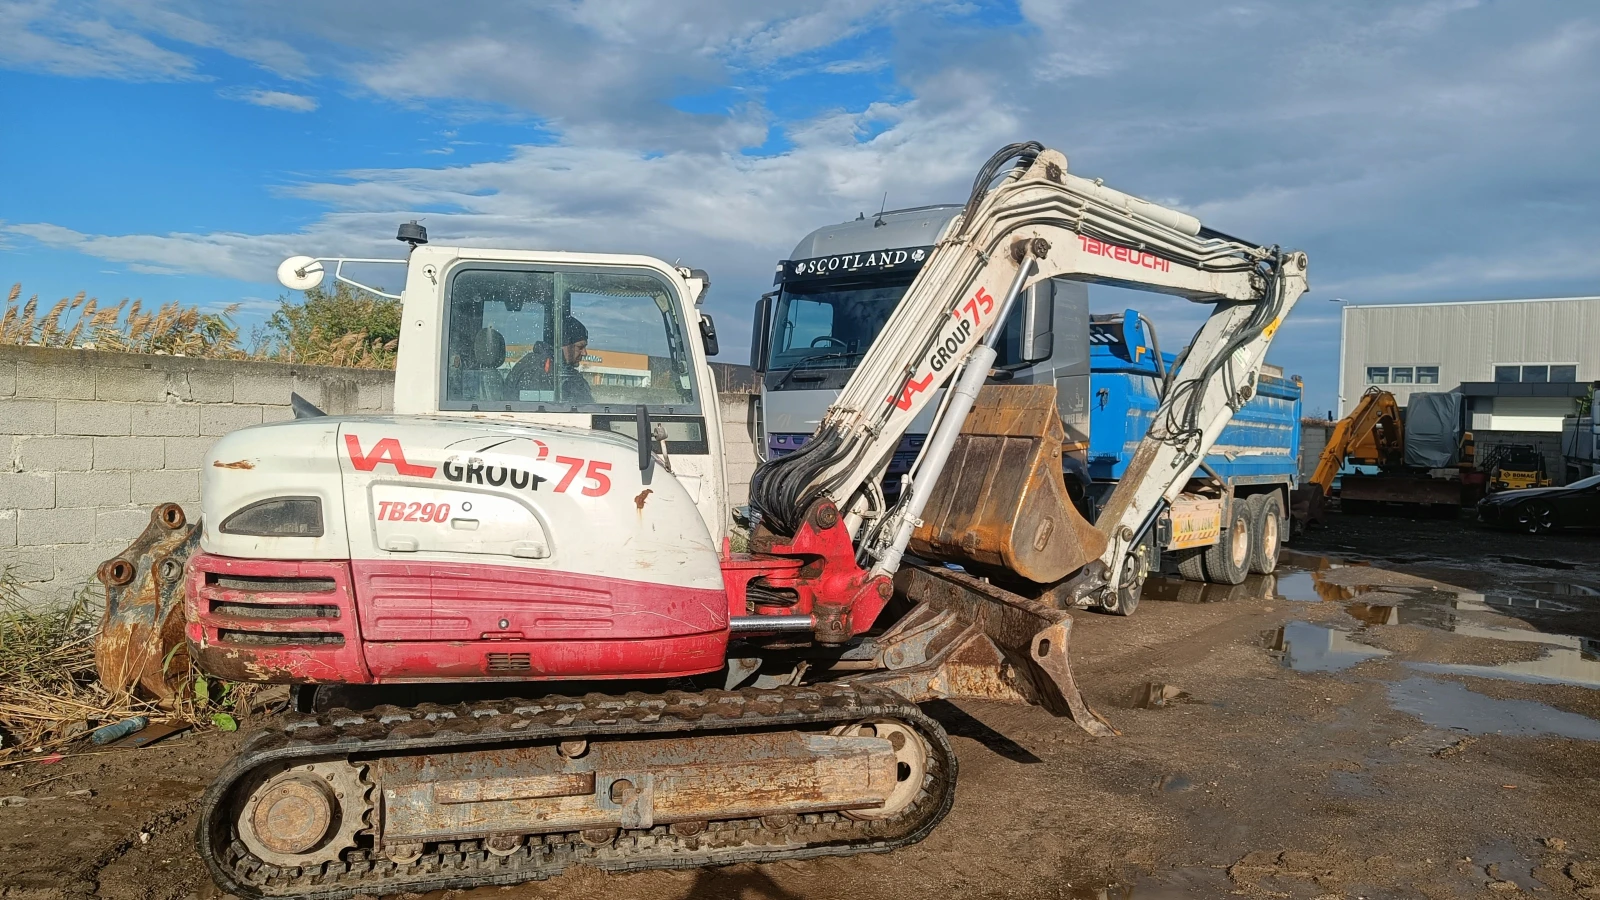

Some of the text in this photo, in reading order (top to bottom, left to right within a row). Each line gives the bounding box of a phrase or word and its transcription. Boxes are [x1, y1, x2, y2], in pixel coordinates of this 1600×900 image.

[807, 250, 908, 274] SCOTLAND
[930, 319, 971, 372] GROUP
[963, 286, 994, 327] 75
[344, 434, 612, 497] VAL GROUP 75
[377, 500, 451, 523] TB290
